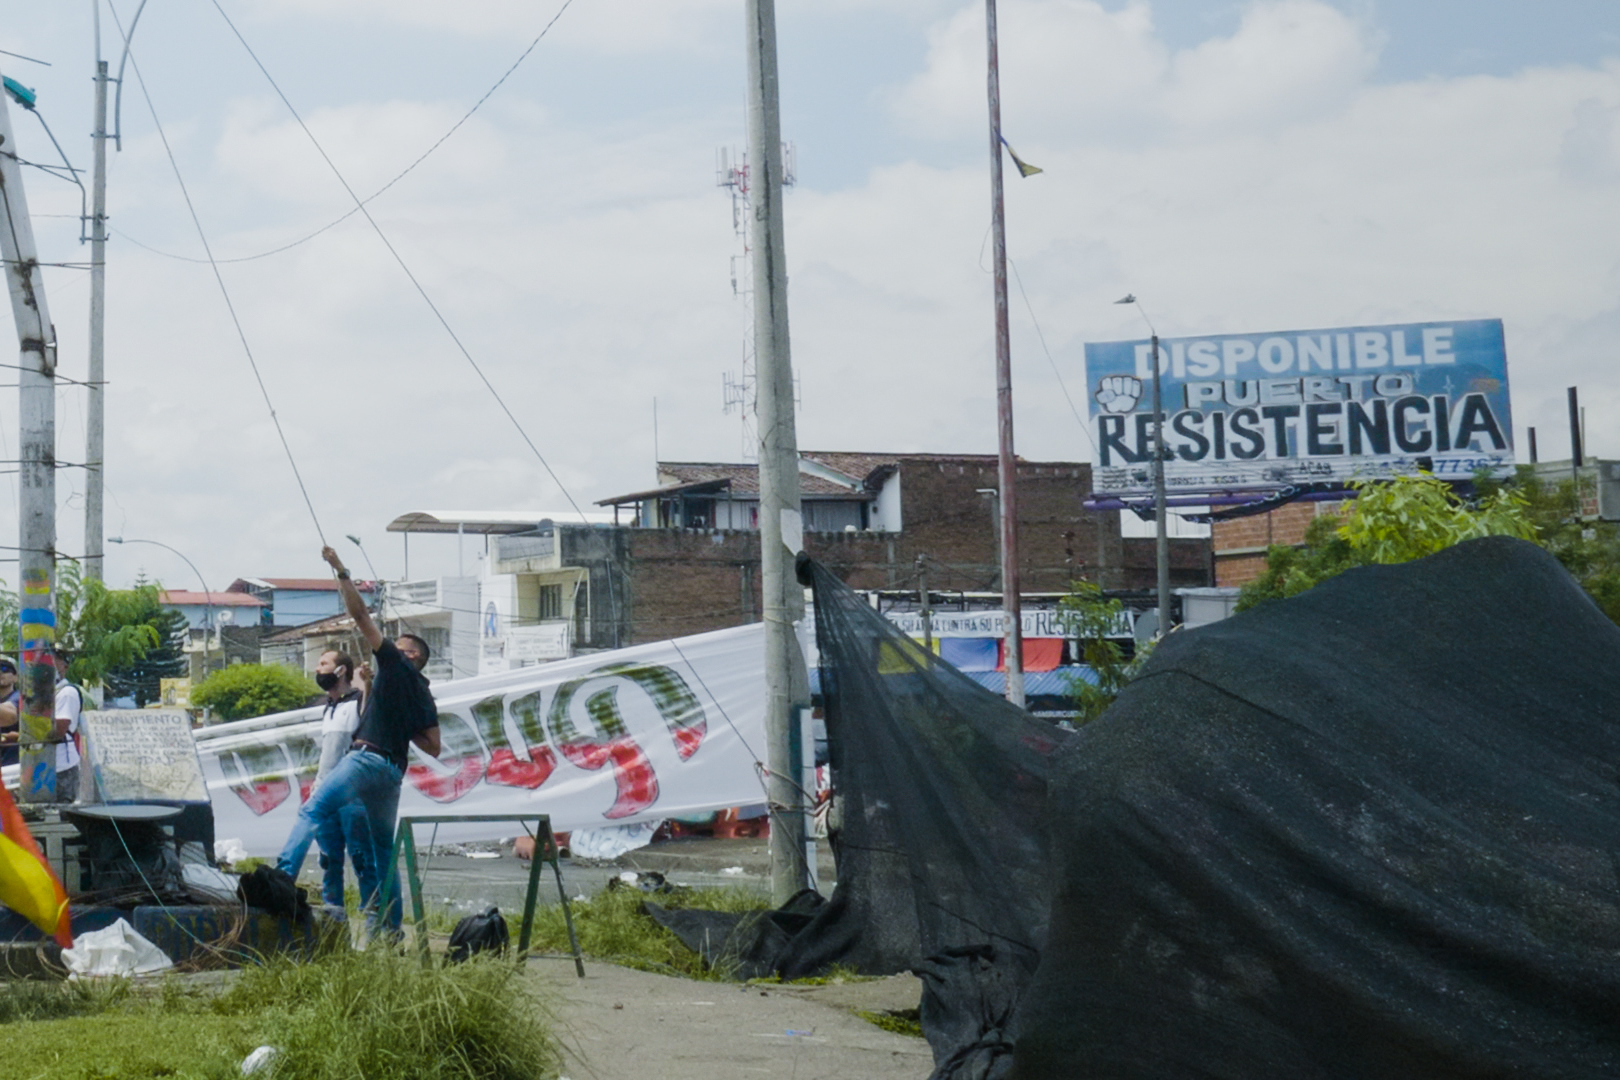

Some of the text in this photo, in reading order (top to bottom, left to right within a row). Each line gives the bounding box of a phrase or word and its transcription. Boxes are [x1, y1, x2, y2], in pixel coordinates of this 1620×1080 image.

[1135, 327, 1456, 380] DISPONIBLE
[1183, 373, 1414, 409] PUERTO
[1098, 393, 1508, 467] RESISTENCIA
